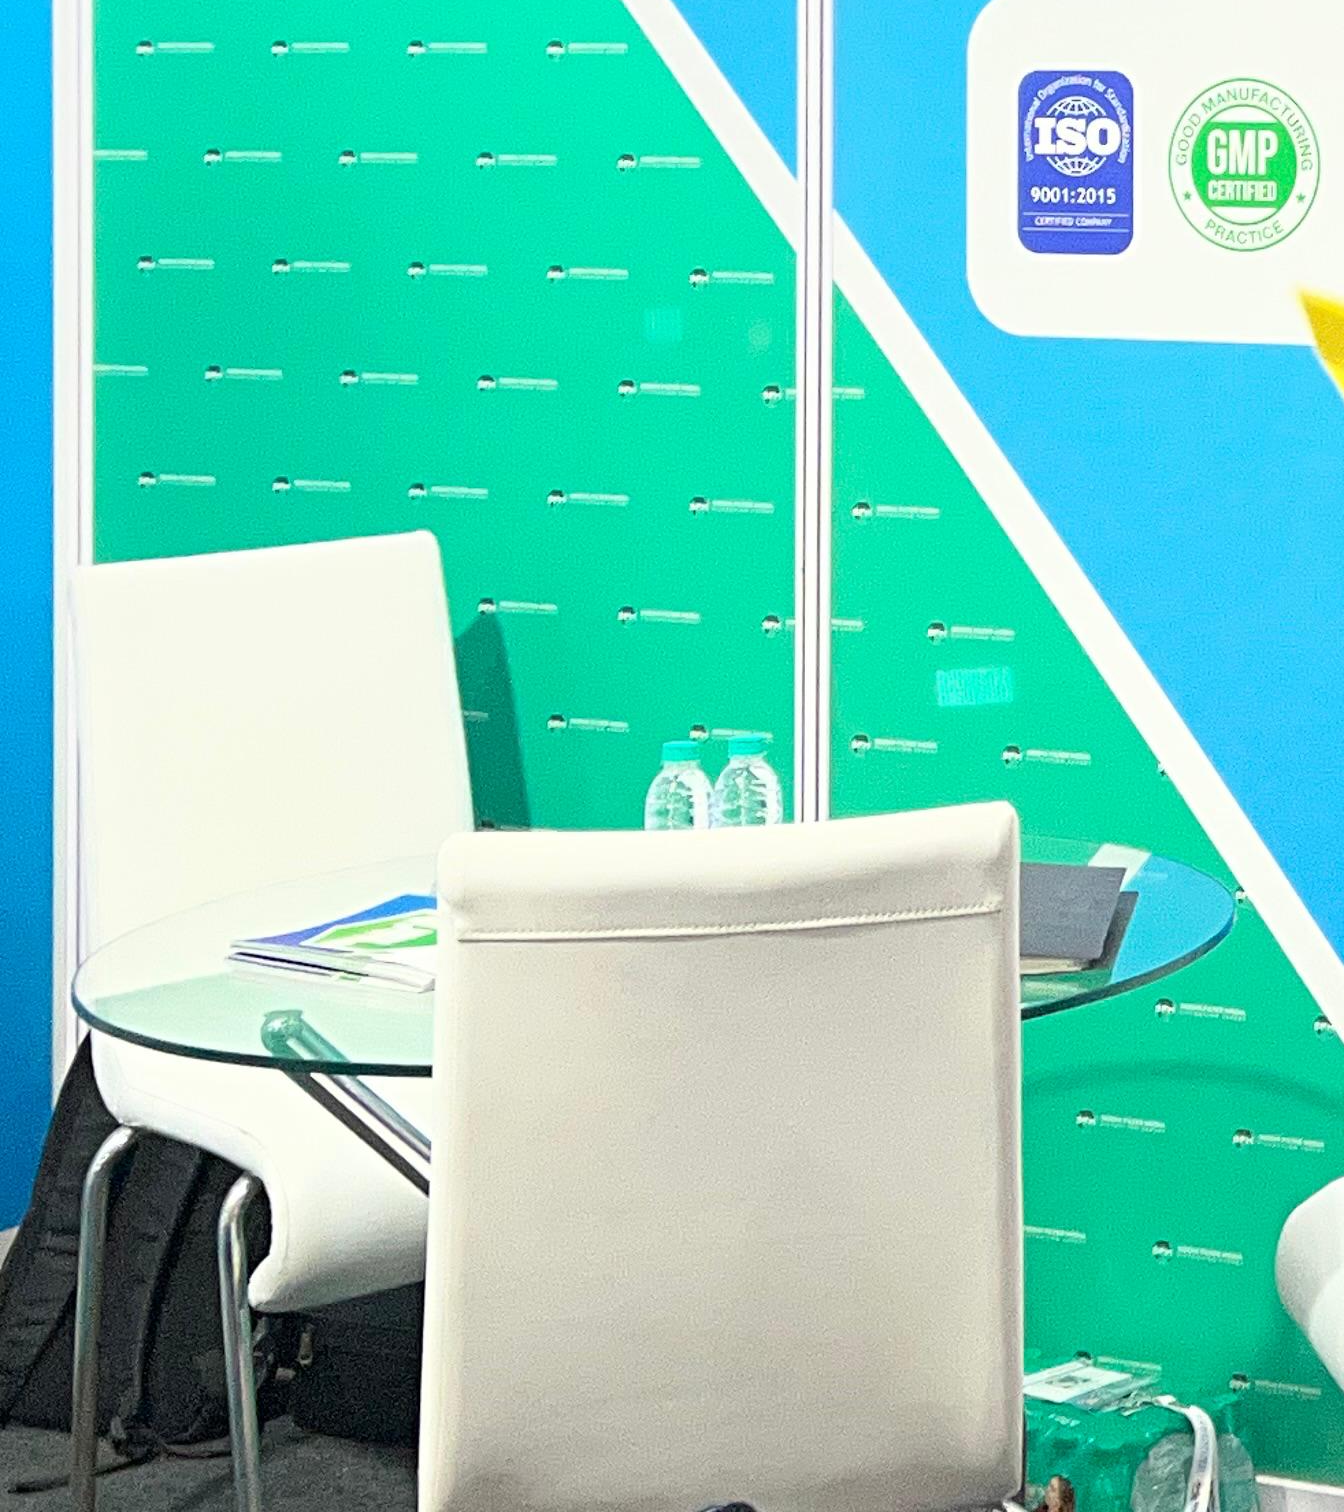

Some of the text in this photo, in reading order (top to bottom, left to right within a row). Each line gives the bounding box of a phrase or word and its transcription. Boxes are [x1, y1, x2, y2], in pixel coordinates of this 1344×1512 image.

[1033, 116, 1122, 157] ISO
[1175, 88, 1313, 172] GOOD MANUFACTURING
[1206, 128, 1279, 176] GMP
[1030, 186, 1117, 205] 9001:2015
[1204, 218, 1285, 246] PRACTICE
